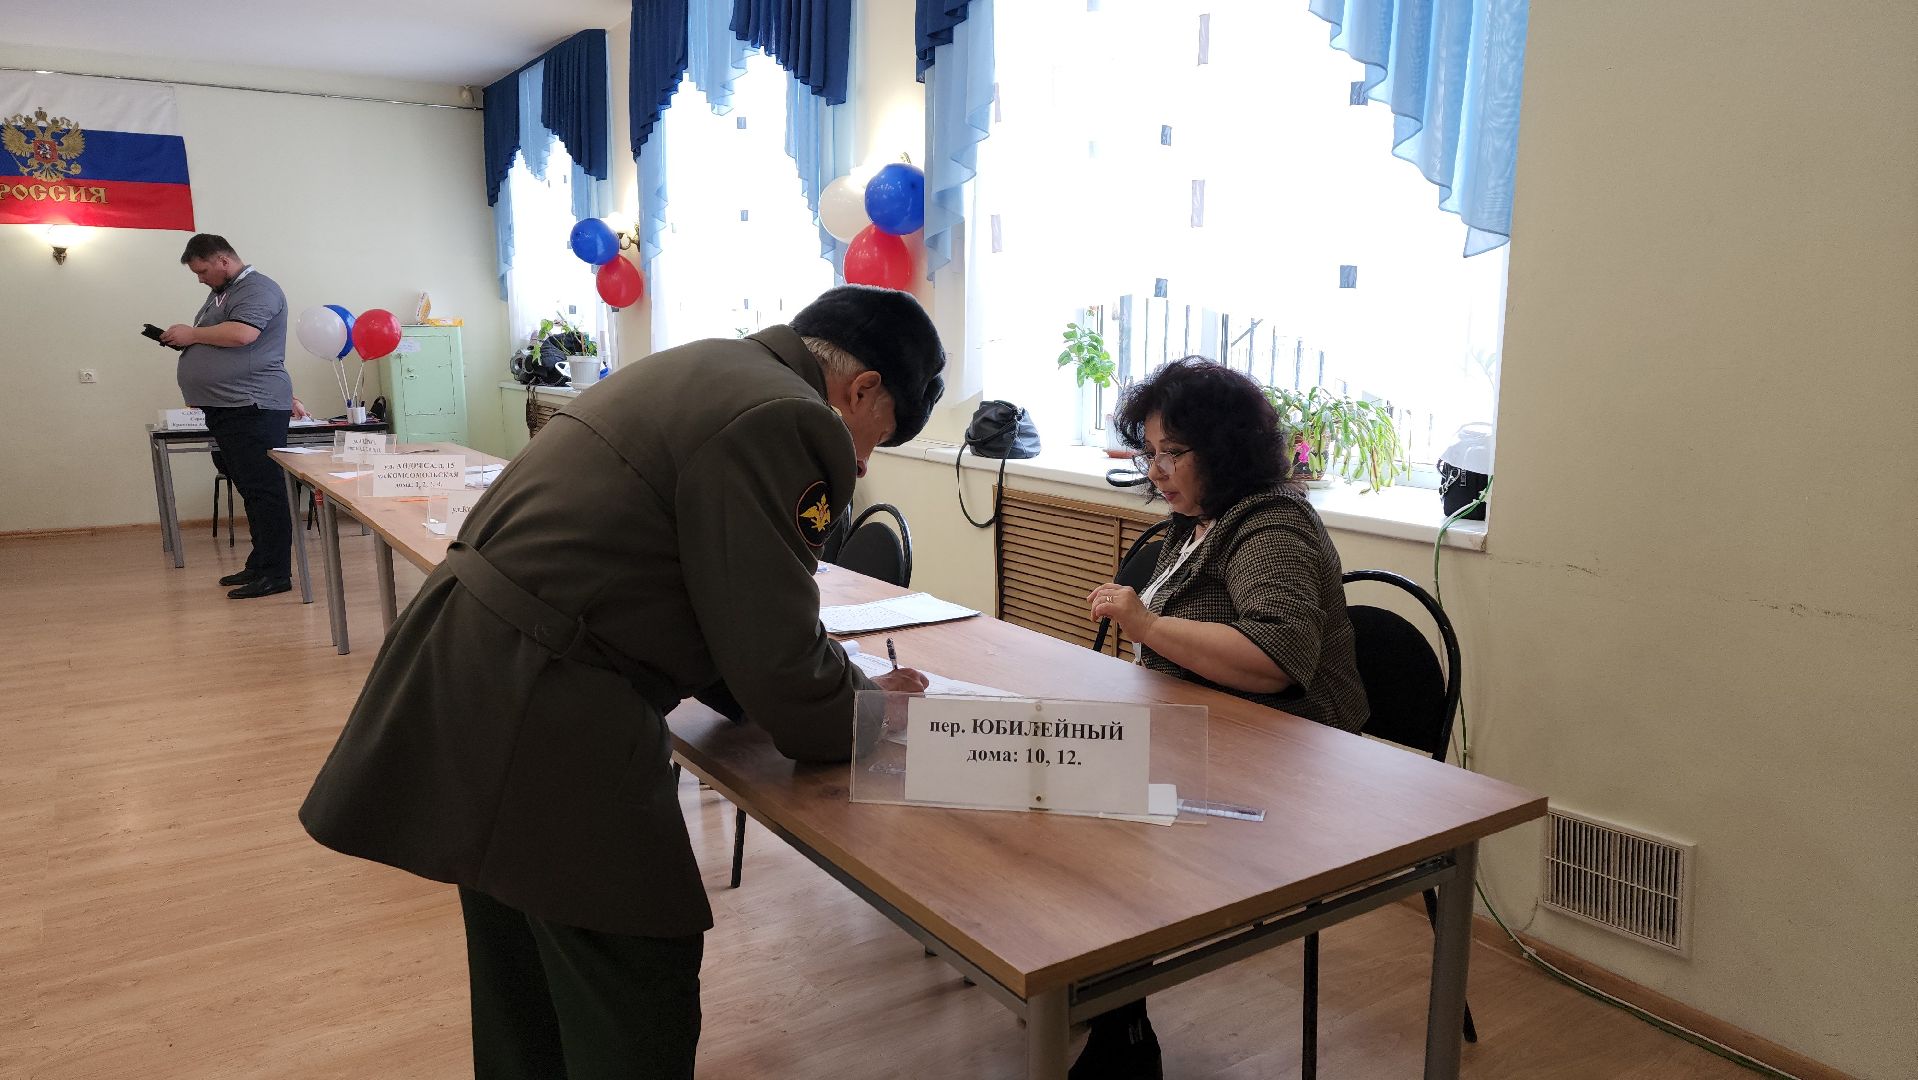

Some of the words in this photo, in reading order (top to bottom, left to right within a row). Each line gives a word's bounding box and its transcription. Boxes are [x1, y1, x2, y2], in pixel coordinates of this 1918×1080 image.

[0, 183, 109, 204] РОССИЯ
[930, 720, 966, 737] пер.
[972, 718, 1125, 741] ЮБИЛЕЙНЫЙ
[966, 749, 1019, 763] дома:
[1025, 747, 1051, 767] 10,
[1057, 749, 1082, 765] 12.
